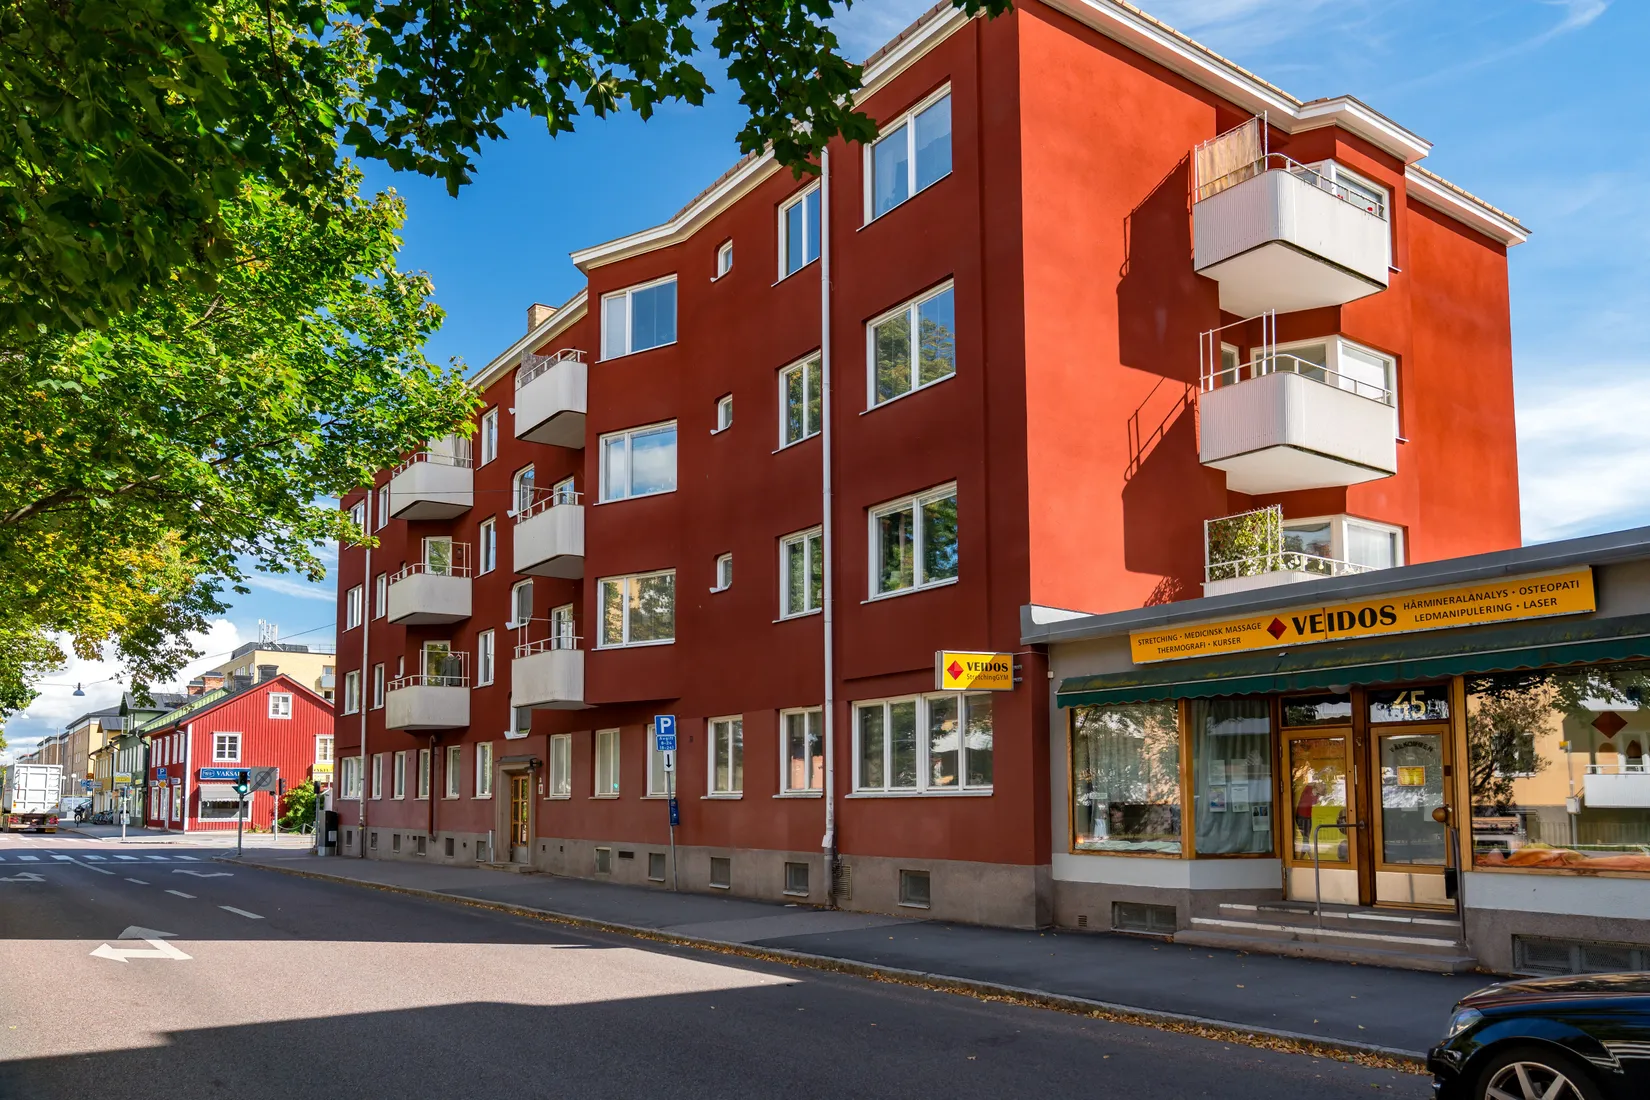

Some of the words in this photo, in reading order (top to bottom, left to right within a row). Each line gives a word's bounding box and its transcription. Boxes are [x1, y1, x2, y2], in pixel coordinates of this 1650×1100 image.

[1403, 589, 1508, 610] HÅRMINERALANALYS
[1519, 580, 1580, 595] OSTEOPATI
[1292, 605, 1397, 635] VEIDOS
[1414, 603, 1512, 622] LEDMANIPULERING
[1523, 598, 1557, 609] LASER
[1138, 634, 1178, 646] STRETCHING
[1184, 628, 1223, 639] MEDICINSK
[1225, 622, 1262, 634] MASSAGE
[1157, 641, 1206, 654] THERMOGRAFI
[1212, 637, 1241, 647] KURSER
[966, 661, 1009, 672] VEIDOS
[1391, 690, 1426, 718] 45
[660, 717, 672, 734] P
